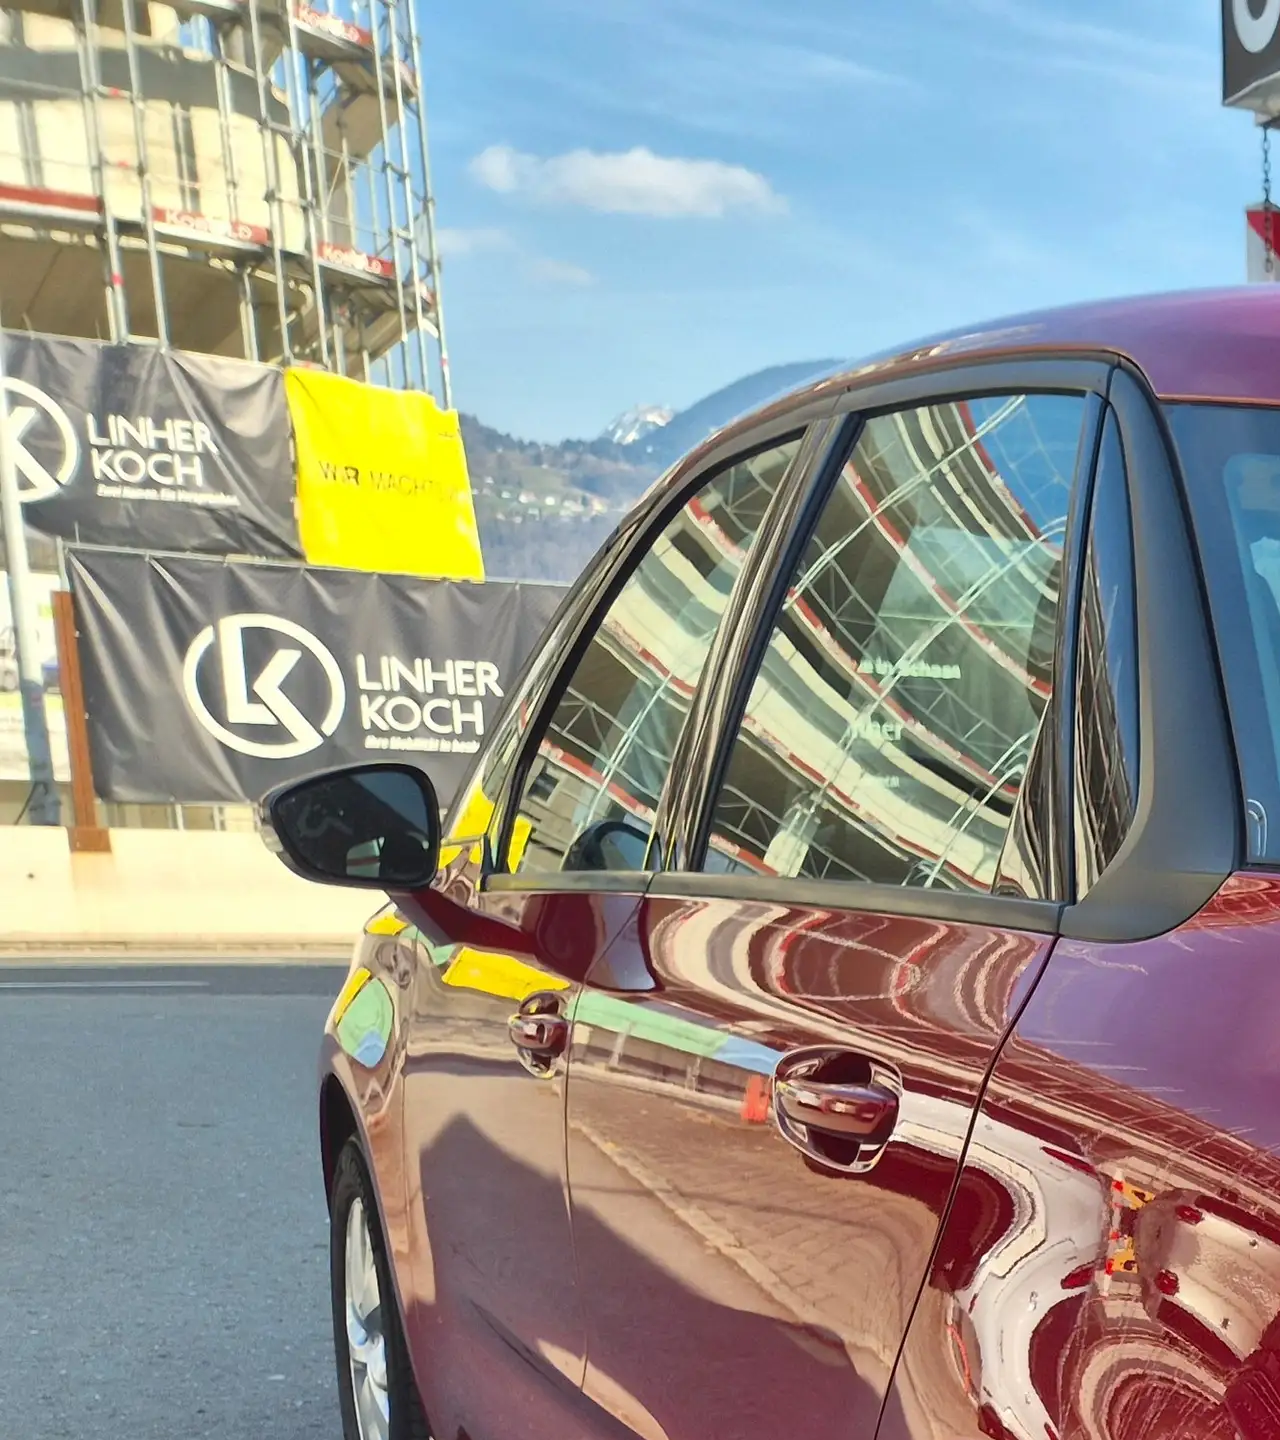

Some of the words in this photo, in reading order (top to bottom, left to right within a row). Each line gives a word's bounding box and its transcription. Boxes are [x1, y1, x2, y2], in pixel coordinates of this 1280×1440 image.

[86, 412, 220, 455] LINHER
[91, 448, 204, 487] KOCH
[356, 653, 504, 697] LINHER
[360, 694, 484, 736] KOCH
